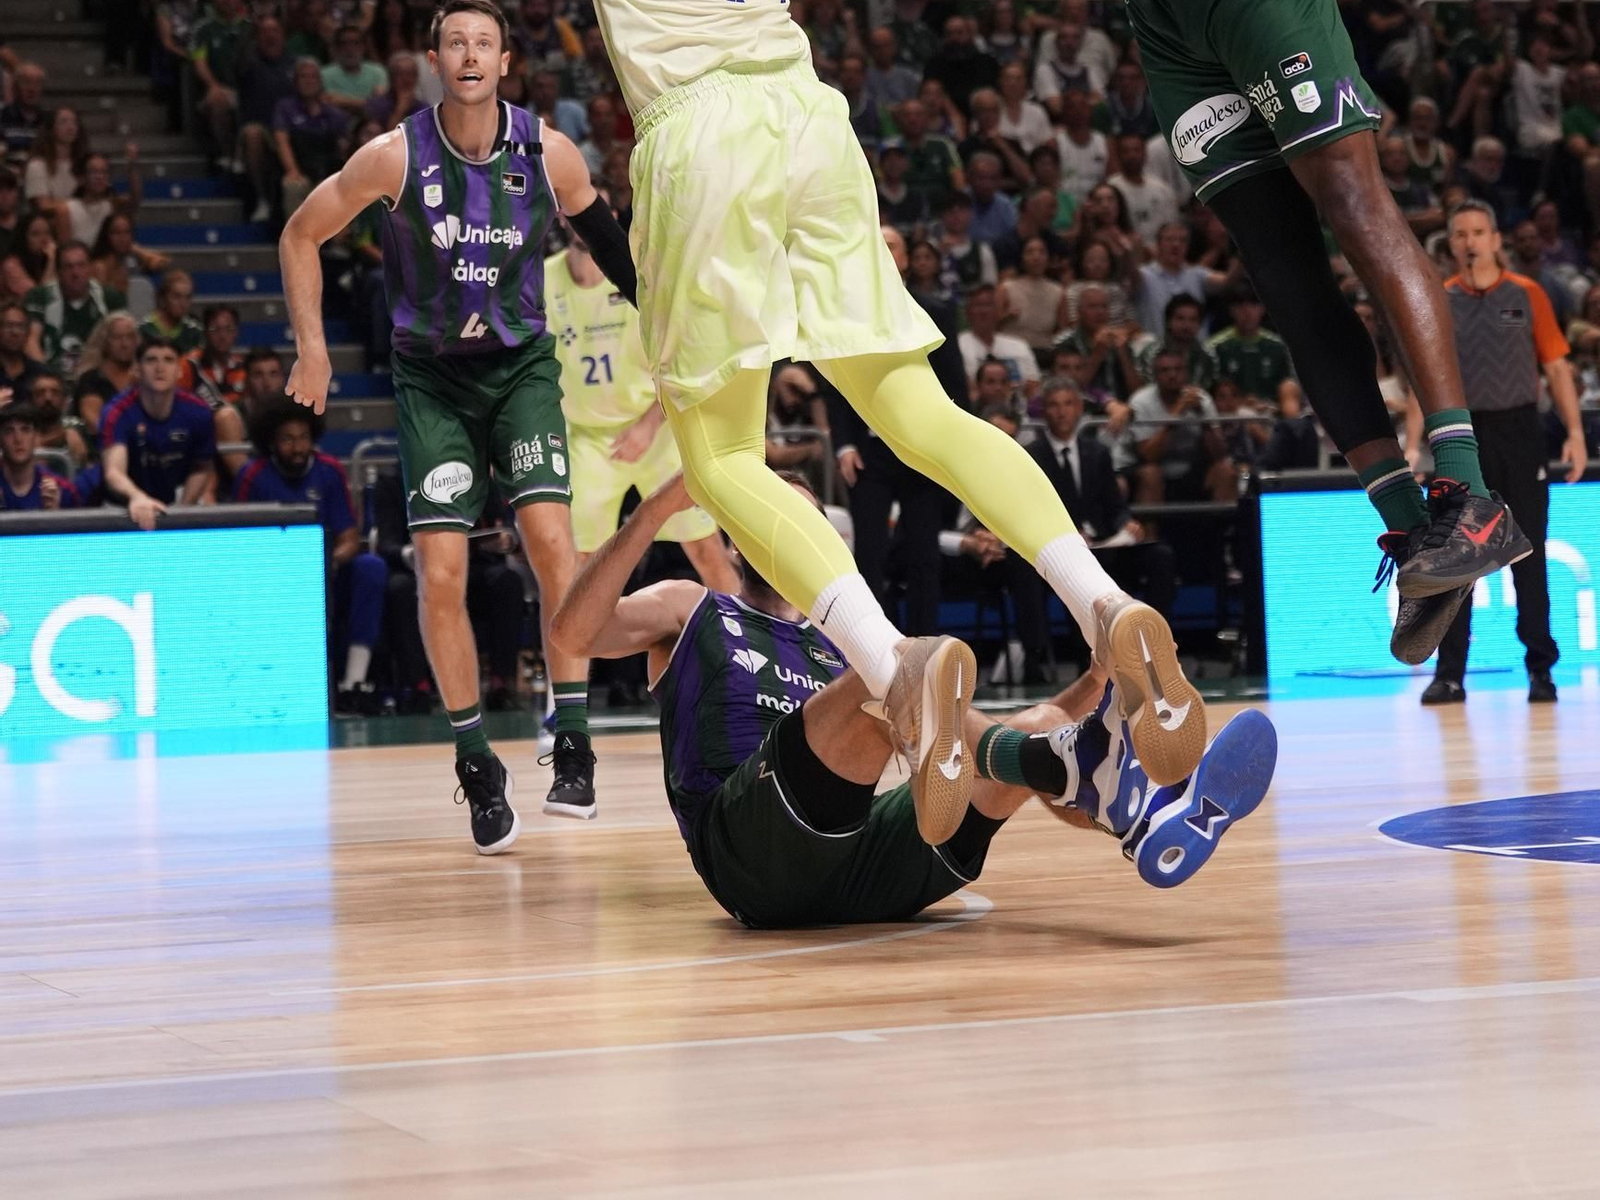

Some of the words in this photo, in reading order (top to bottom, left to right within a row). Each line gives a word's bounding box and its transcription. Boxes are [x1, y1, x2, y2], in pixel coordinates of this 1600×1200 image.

[1284, 62, 1305, 75] acb
[1174, 99, 1246, 160] famadesa
[457, 224, 523, 250] Unicaja
[460, 312, 489, 339] 4
[581, 353, 613, 386] 21
[0, 593, 157, 722] a
